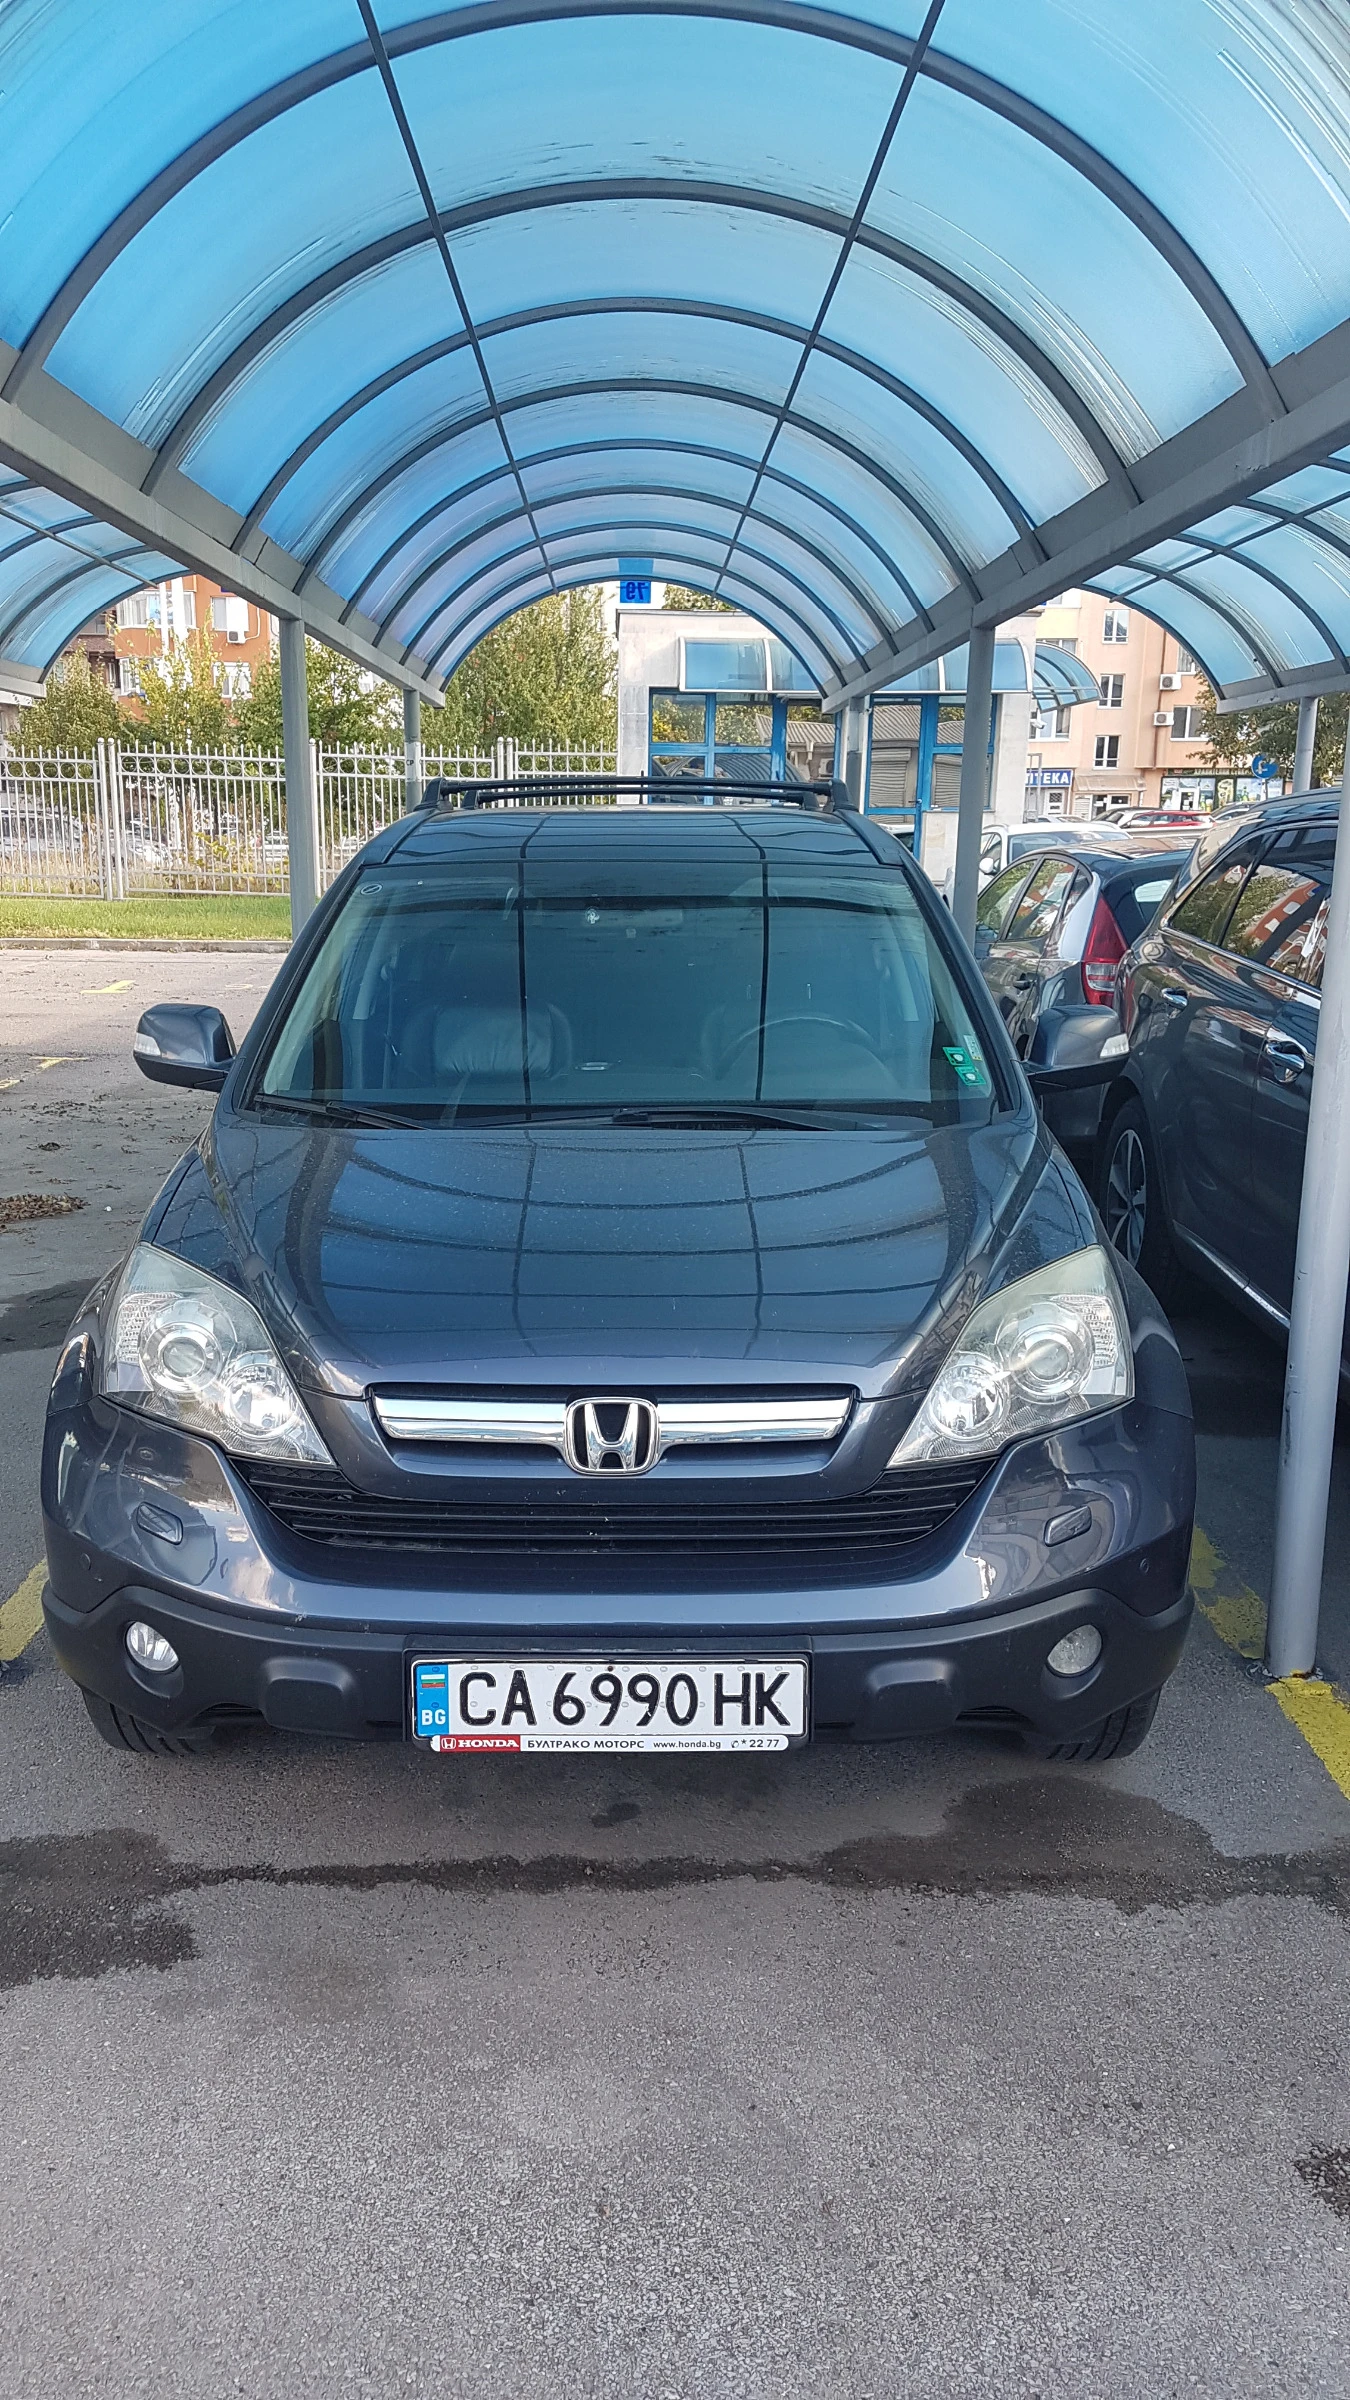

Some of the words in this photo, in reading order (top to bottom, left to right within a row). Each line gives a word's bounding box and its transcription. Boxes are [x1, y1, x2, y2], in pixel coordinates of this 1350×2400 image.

[553, 1672, 699, 1727] 6990
[421, 1709, 446, 1726] BG
[457, 1738, 520, 1748] HONDA
[653, 1740, 722, 1749] www.honda.bg
